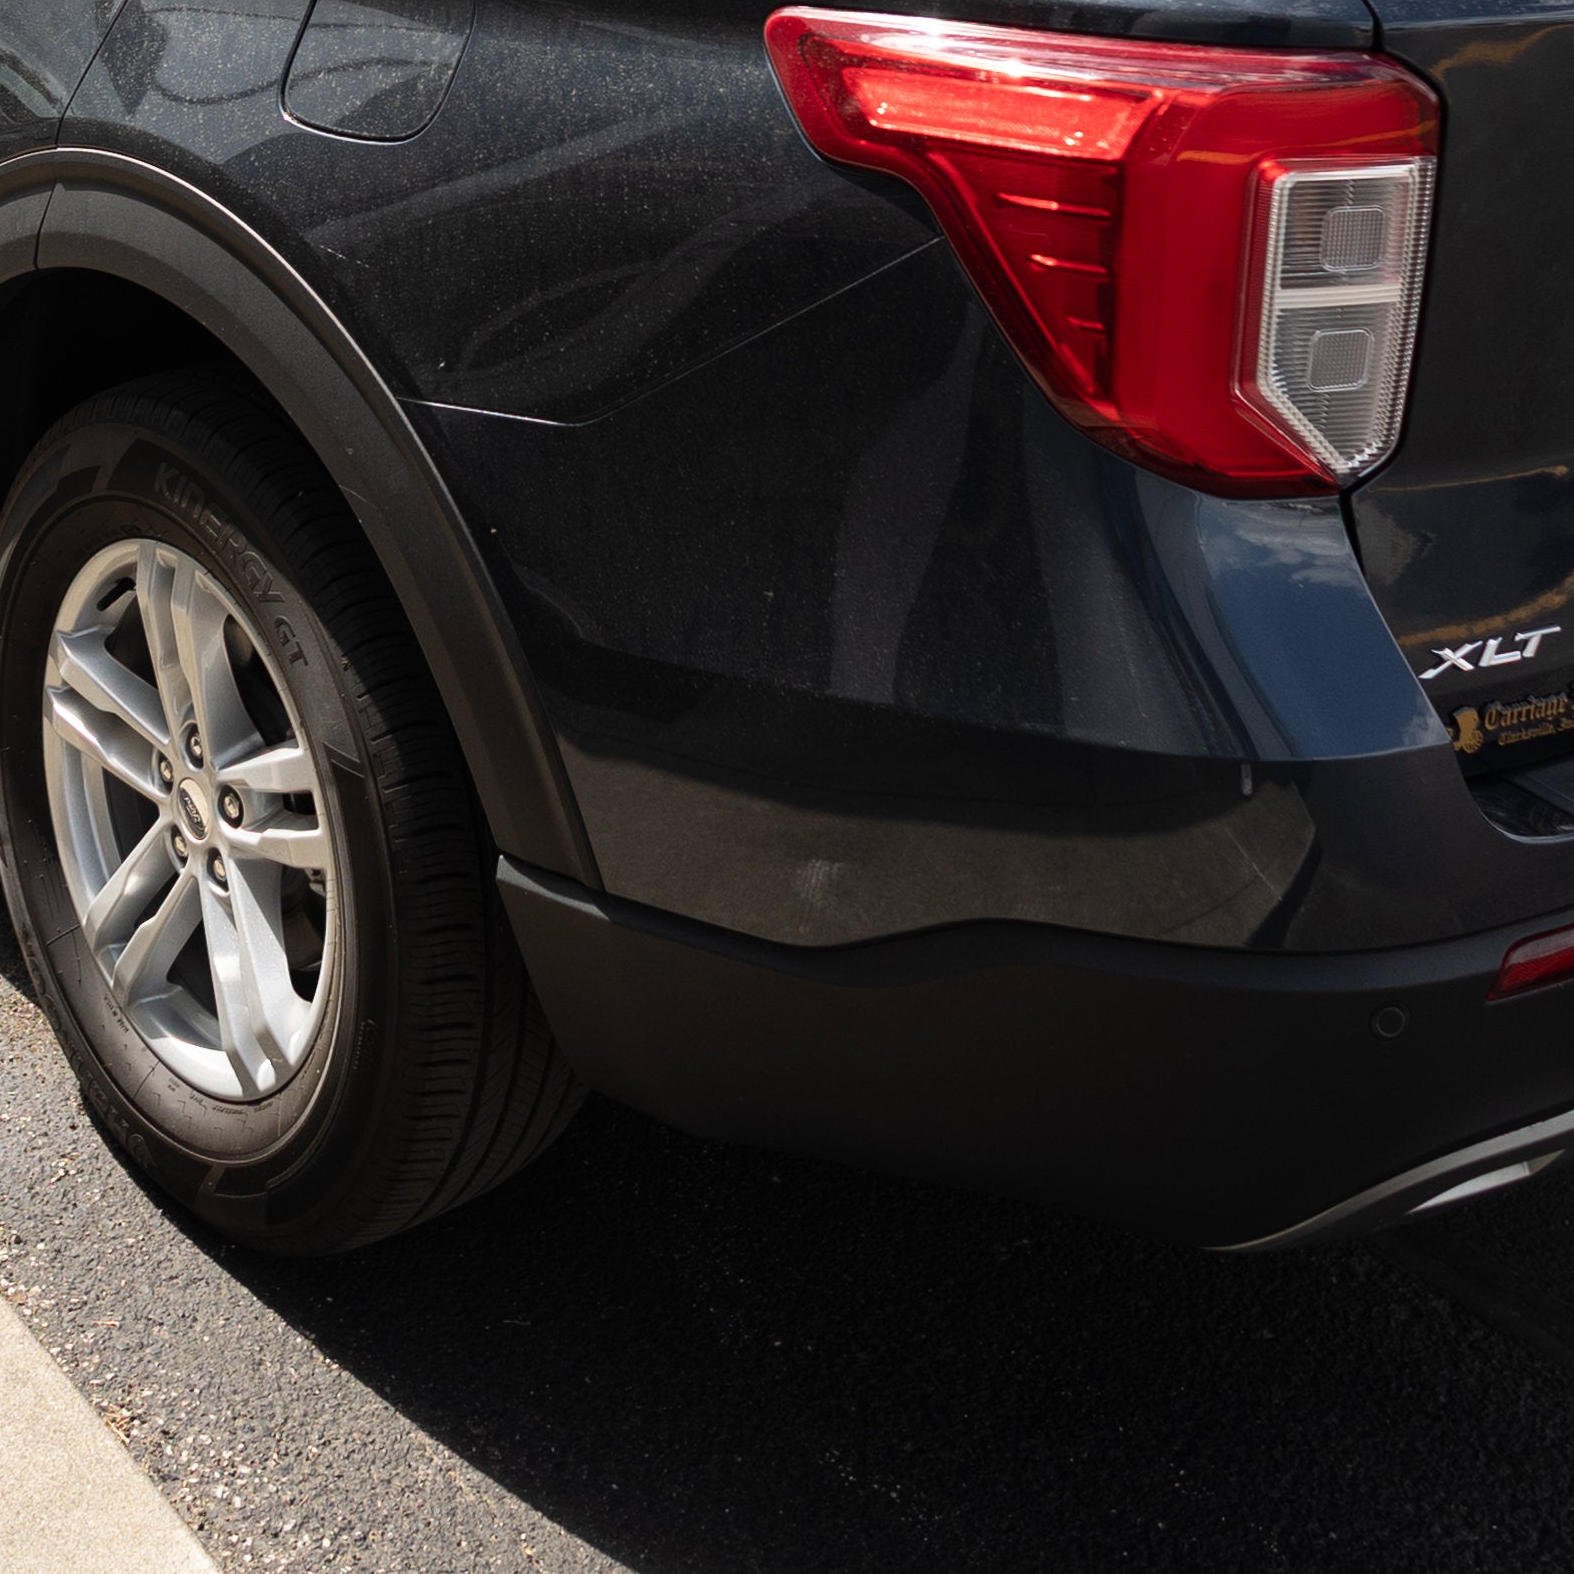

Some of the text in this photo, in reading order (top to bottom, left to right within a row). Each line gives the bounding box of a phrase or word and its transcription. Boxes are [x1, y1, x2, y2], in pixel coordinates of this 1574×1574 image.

[153, 461, 309, 667] KINERGY GT
[1418, 625, 1562, 679] XLT
[1484, 693, 1569, 731] Carriage
